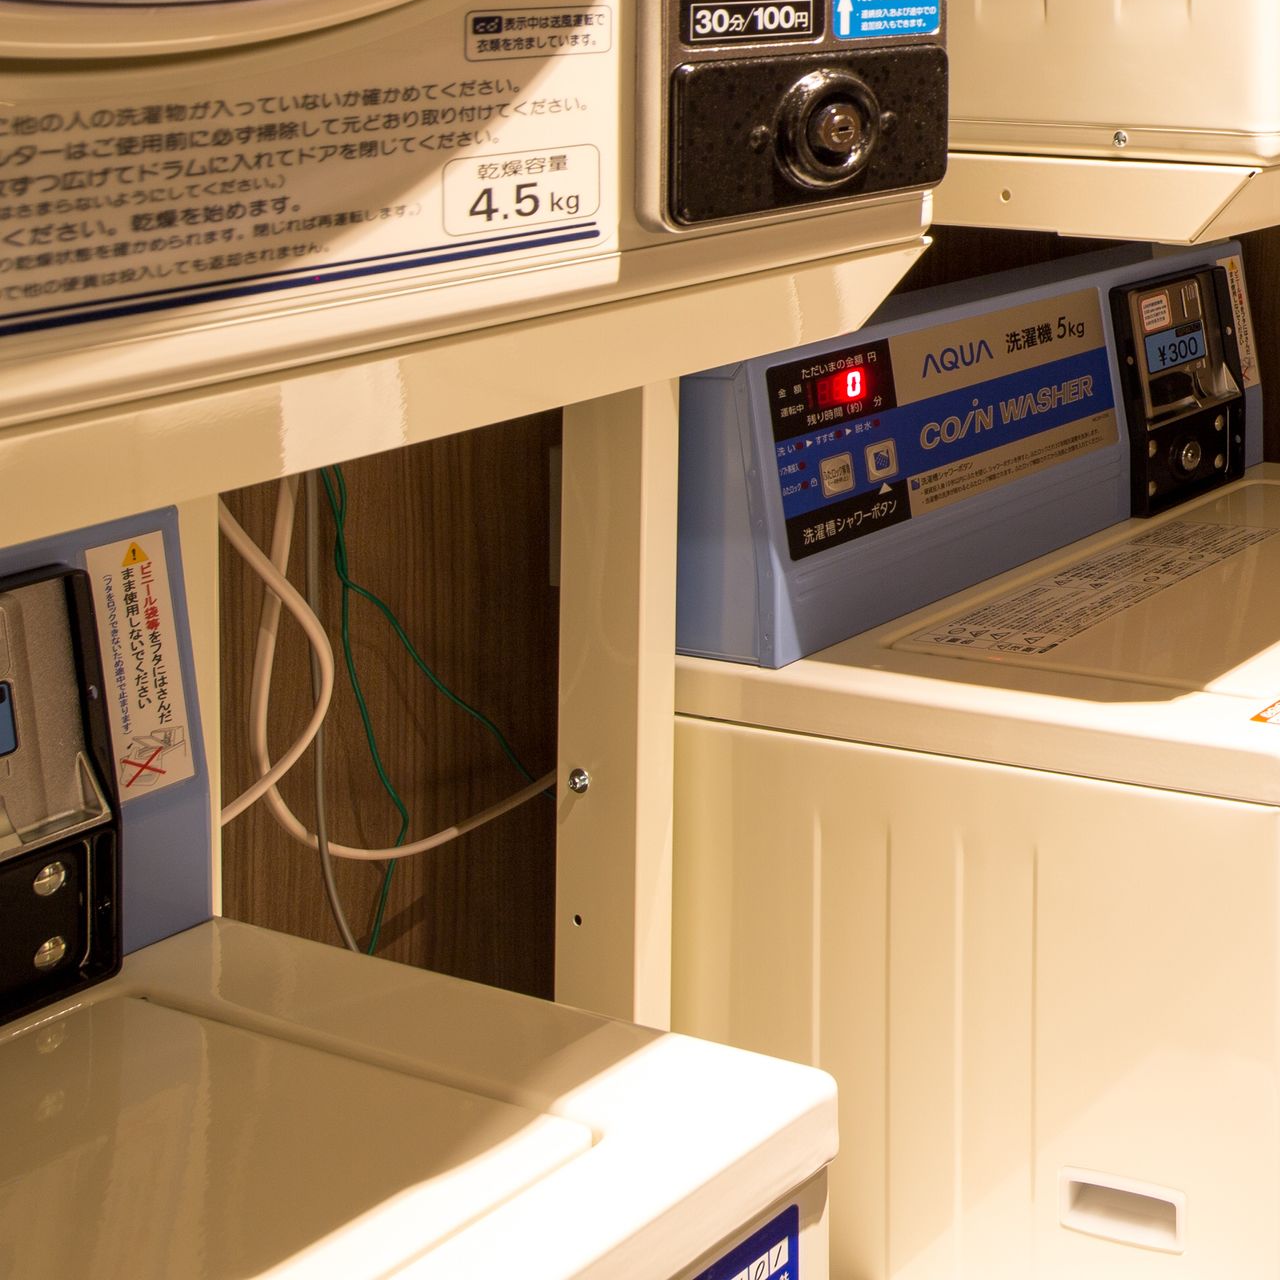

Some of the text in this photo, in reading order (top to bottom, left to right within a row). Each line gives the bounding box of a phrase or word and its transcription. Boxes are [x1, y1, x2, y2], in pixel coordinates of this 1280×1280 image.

[695, 5, 808, 34] 30分/100円
[476, 34, 597, 53] 衣類を冷ましています。
[476, 154, 568, 181] 乾燥容量
[469, 182, 579, 222] 4.5 kg
[922, 316, 1085, 378] AQUA 洗濯機 5kg
[1158, 336, 1198, 366] ¥300
[801, 351, 877, 380] ただいまの金額 円
[846, 371, 861, 397] 0
[780, 404, 804, 418] 運転中
[874, 395, 882, 408] 分
[1000, 374, 1094, 424] WASHER
[815, 432, 835, 446] すすぎ
[855, 421, 872, 434] 脱水
[803, 499, 898, 545] 洗濯槽シャワーボタン
[121, 567, 152, 710] まま使用しないでください
